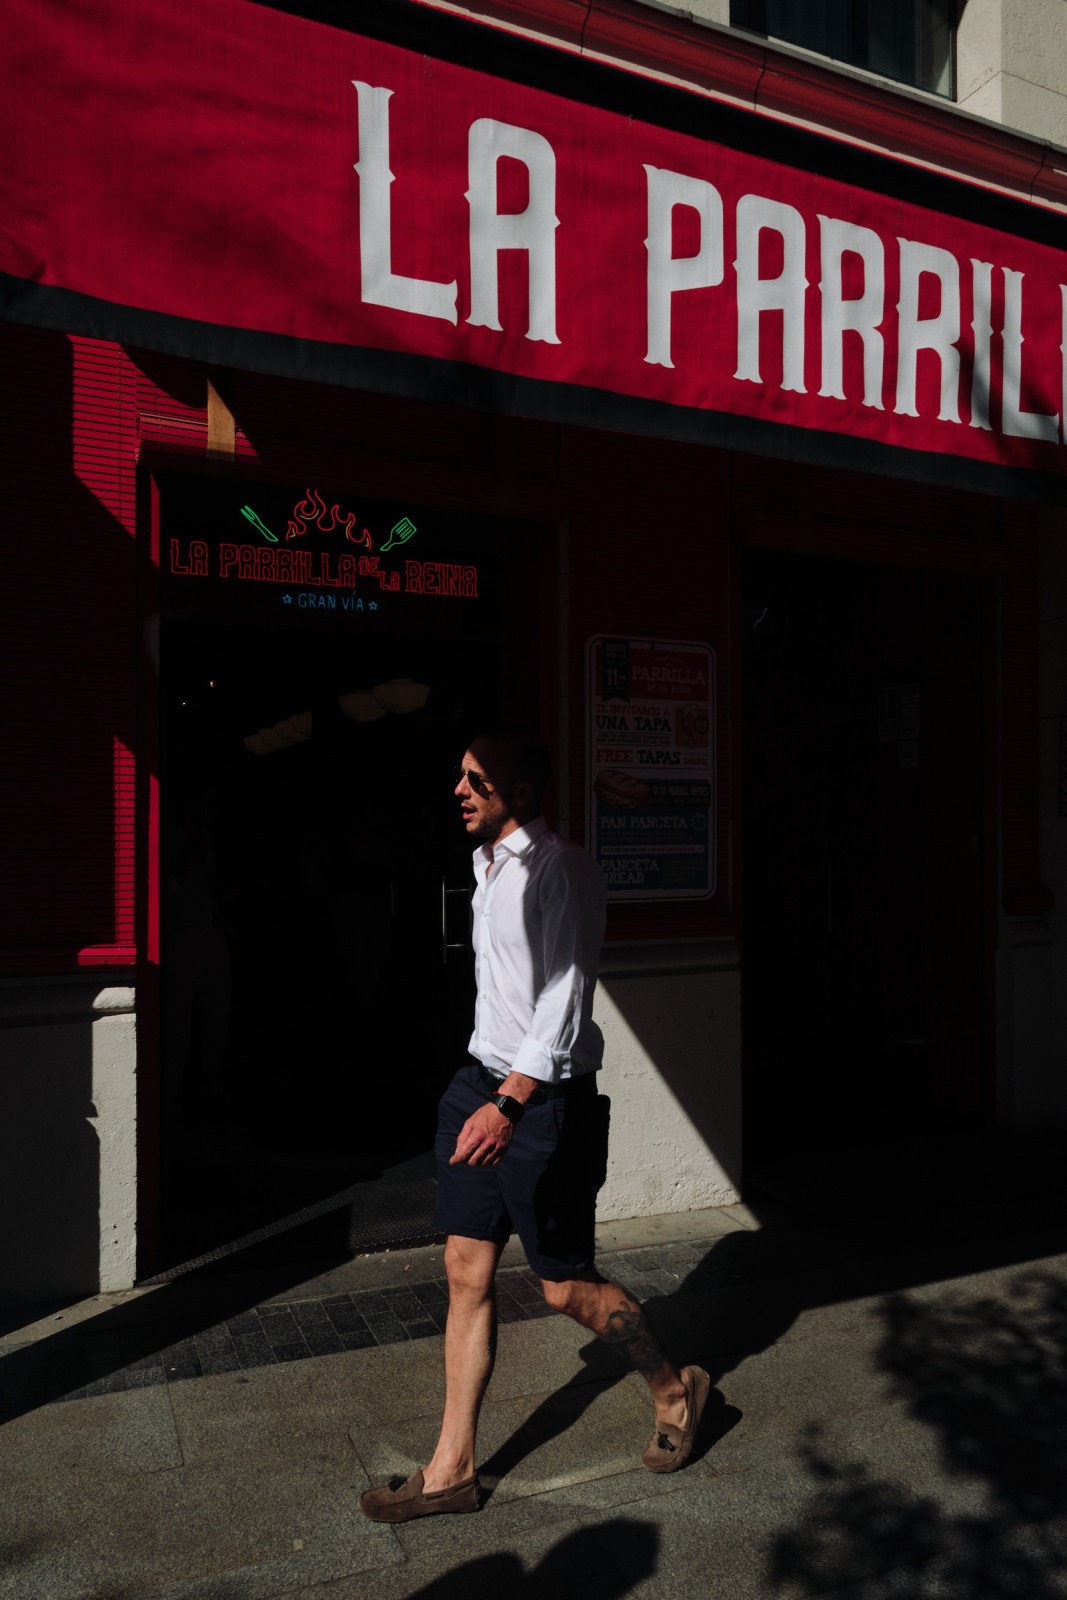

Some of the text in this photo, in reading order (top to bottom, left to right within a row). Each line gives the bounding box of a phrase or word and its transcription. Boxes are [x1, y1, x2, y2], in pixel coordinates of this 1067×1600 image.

[351, 80, 1067, 446] LA PARRIL
[170, 538, 478, 597] LA PARRILLA DE LA REINA
[297, 591, 364, 612] GRAN VÍA
[631, 664, 706, 685] PARRILLA
[610, 704, 660, 716] INVITAMOS
[595, 715, 672, 732] UNA TAPA
[596, 749, 681, 765] FREE TAPAS
[600, 816, 626, 829] PAN
[629, 816, 688, 829] PANCETA
[600, 858, 660, 872] PANCETA
